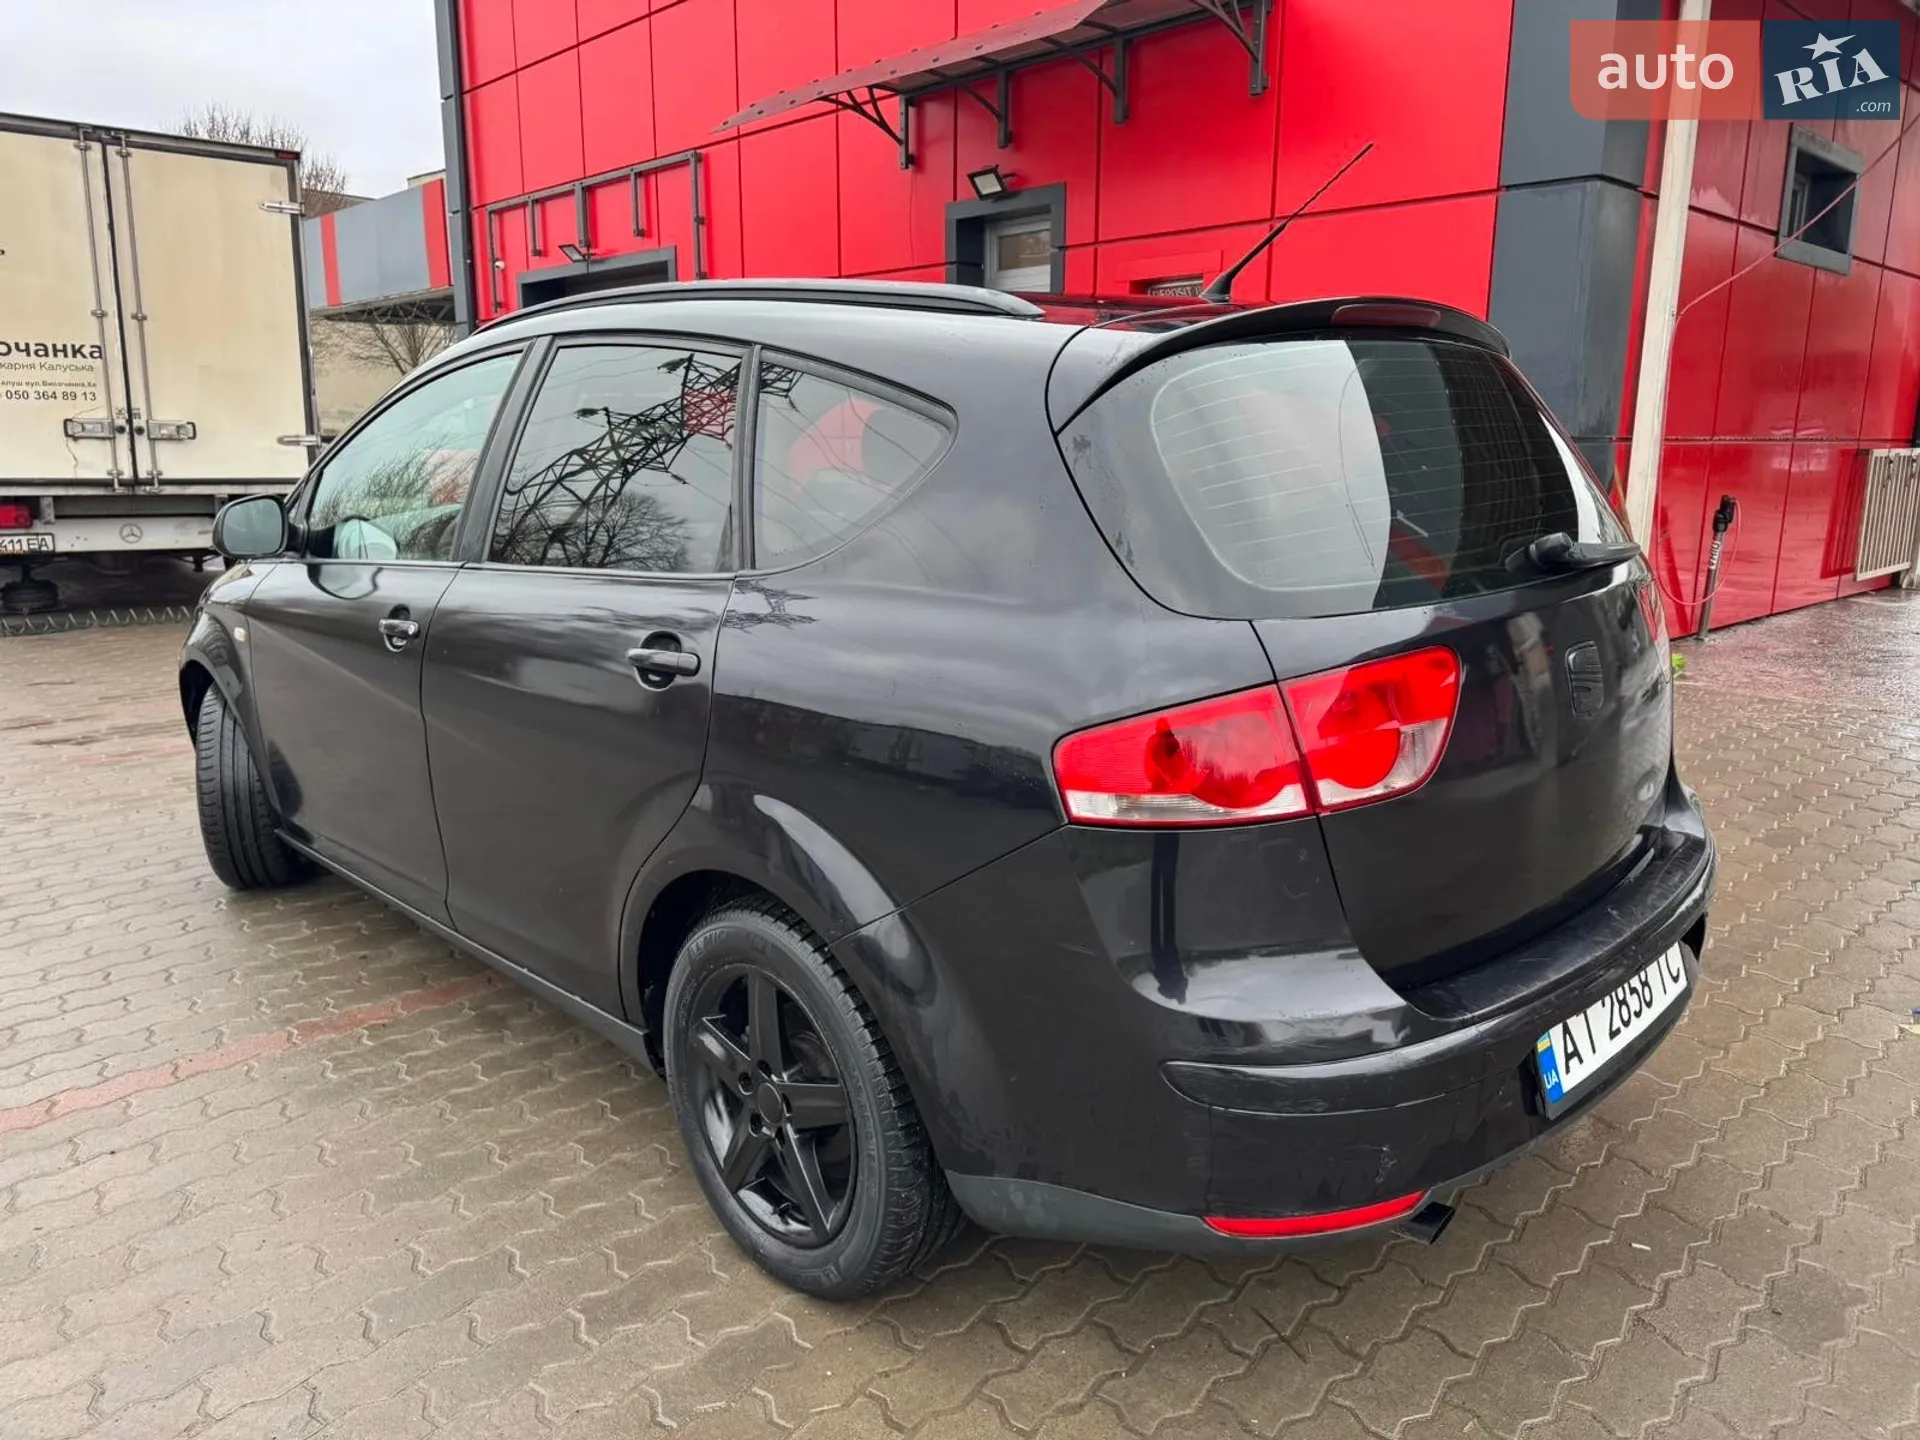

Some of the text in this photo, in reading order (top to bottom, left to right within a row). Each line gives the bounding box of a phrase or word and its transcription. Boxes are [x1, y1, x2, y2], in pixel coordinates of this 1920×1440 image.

[39, 361, 94, 373] Калуська
[5, 389, 97, 401] 050 364 89 13
[1602, 969, 1653, 1041] 2858
[1543, 1070, 1559, 1089] UA
